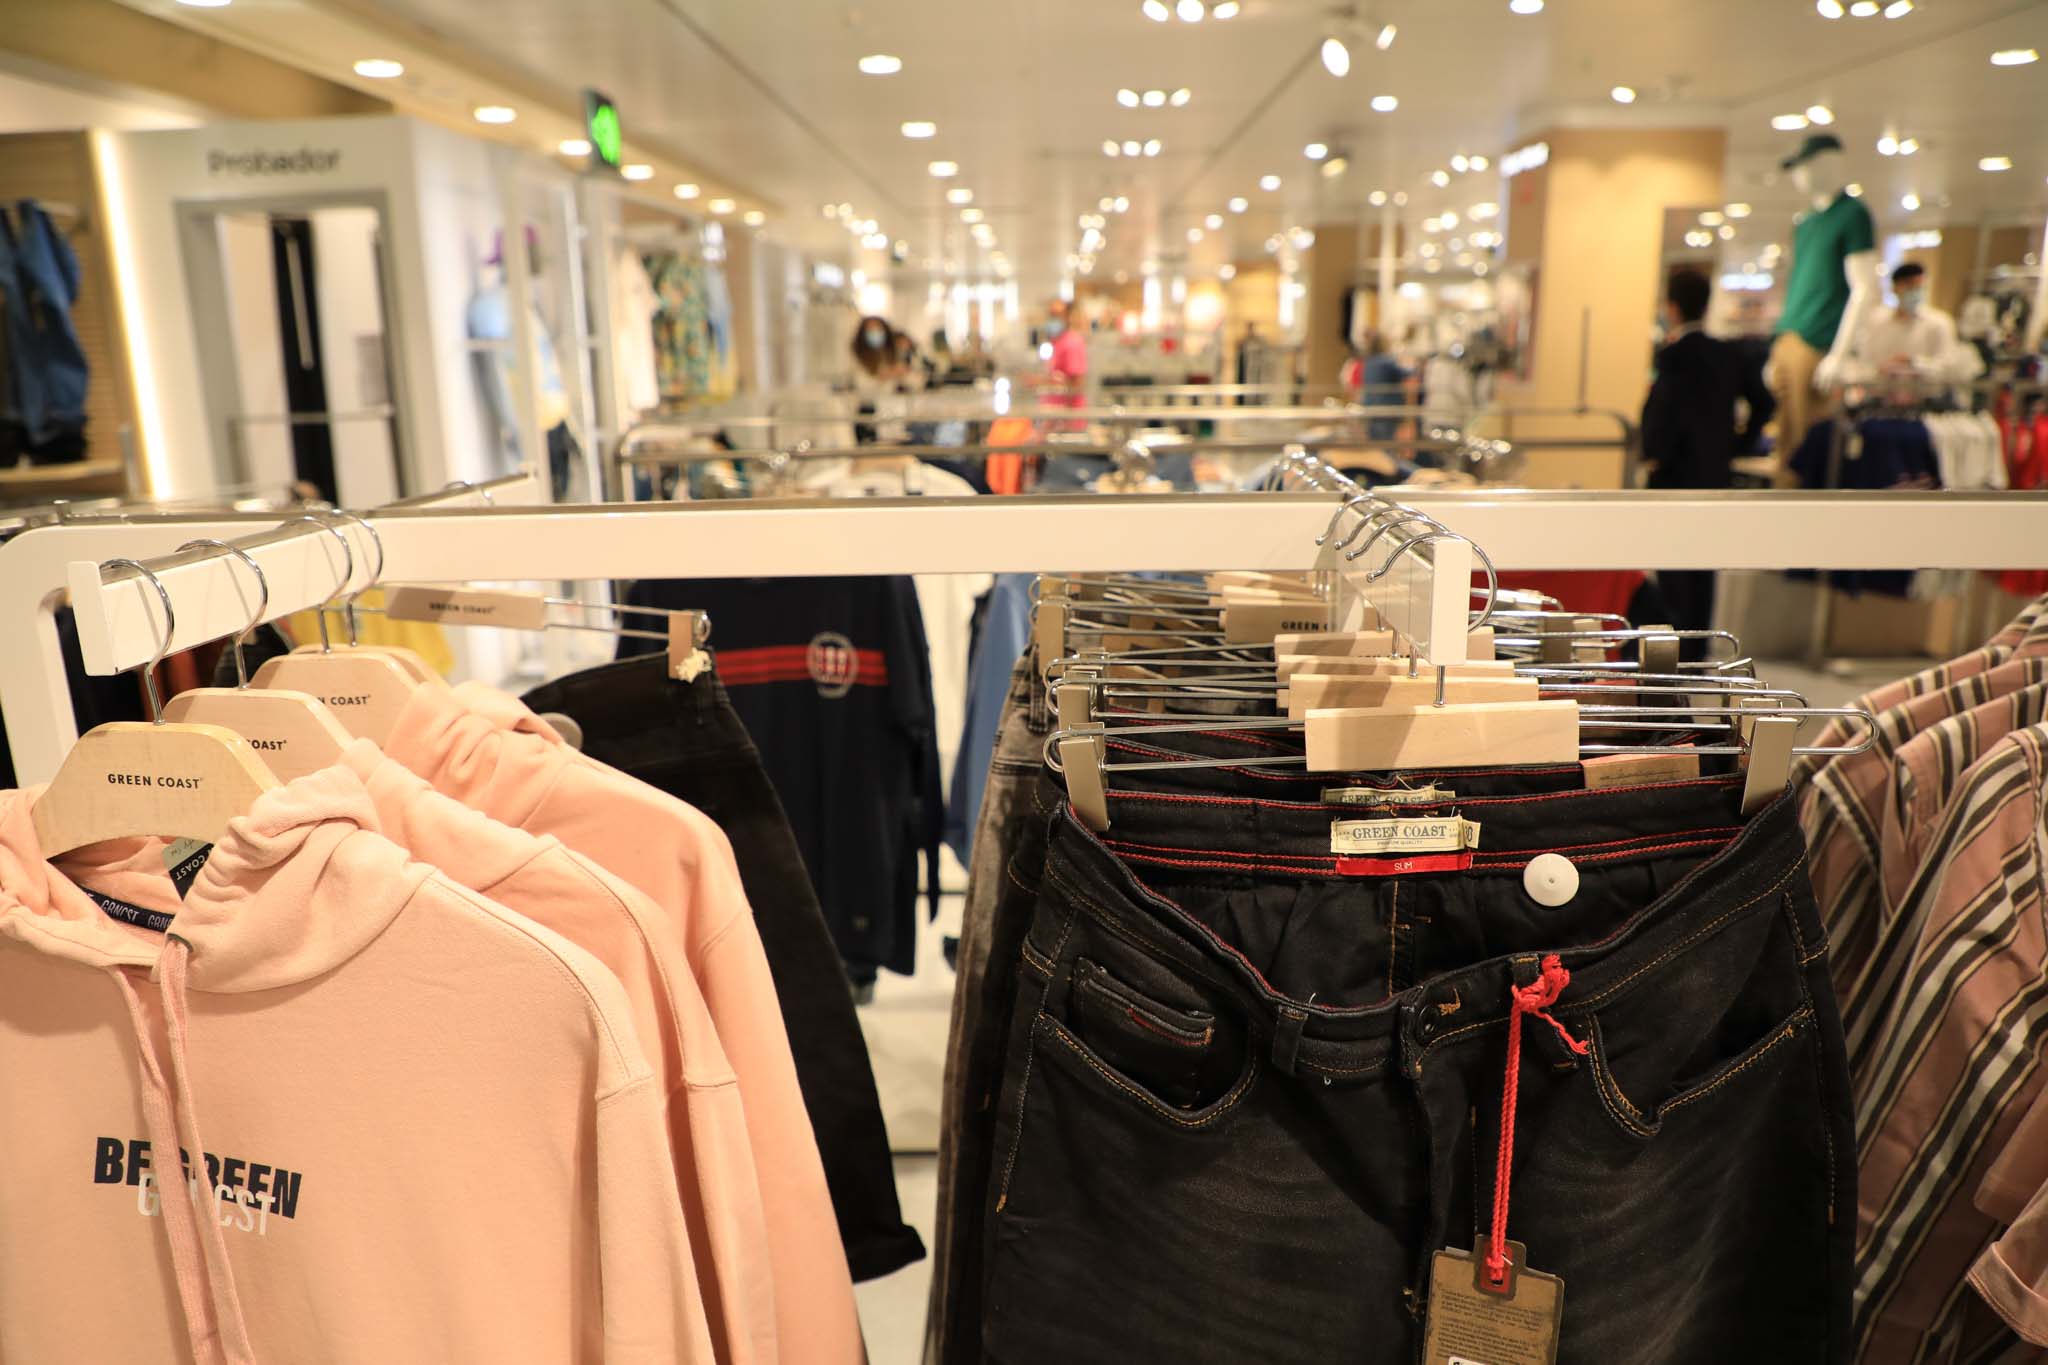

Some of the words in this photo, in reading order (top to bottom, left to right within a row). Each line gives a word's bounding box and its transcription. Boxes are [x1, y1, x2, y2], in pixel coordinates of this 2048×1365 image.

[208, 149, 340, 173] Probador
[1281, 621, 1319, 631] GREEN
[330, 696, 368, 706] COAST
[247, 739, 283, 751] OAST
[107, 773, 152, 787] GREEN
[156, 776, 202, 789] COAST
[1352, 826, 1399, 840] GREEN
[1403, 825, 1447, 838] COAST
[175, 855, 205, 881] COAST
[1394, 862, 1413, 871] SLIM
[102, 900, 139, 922] GRNCST
